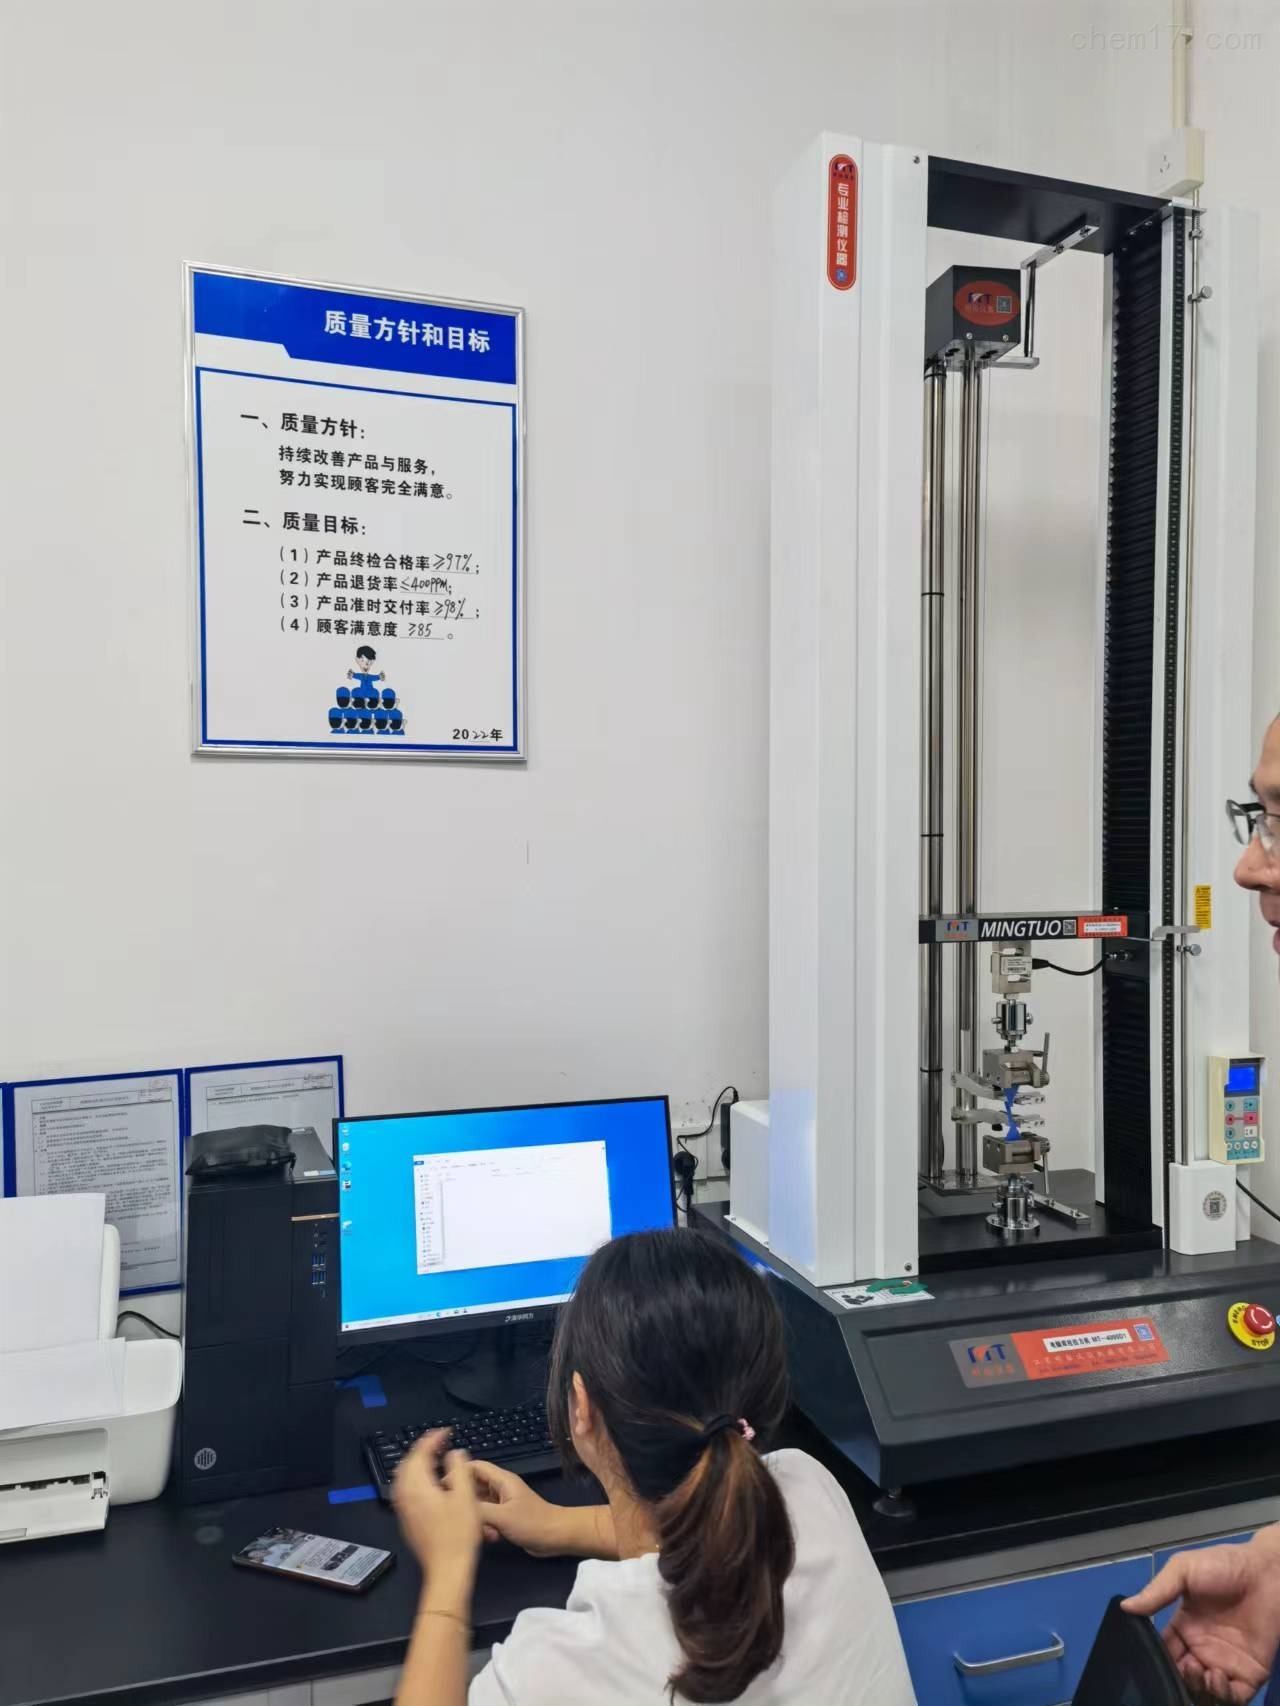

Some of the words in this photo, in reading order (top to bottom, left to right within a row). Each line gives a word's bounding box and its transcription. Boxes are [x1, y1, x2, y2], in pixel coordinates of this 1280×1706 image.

[836, 182, 849, 266] 专业检测仪器
[324, 309, 491, 353] 质量方针和目标
[279, 469, 453, 500] 努力实现顾客完全满意。
[981, 920, 1062, 938] MINGTUO
